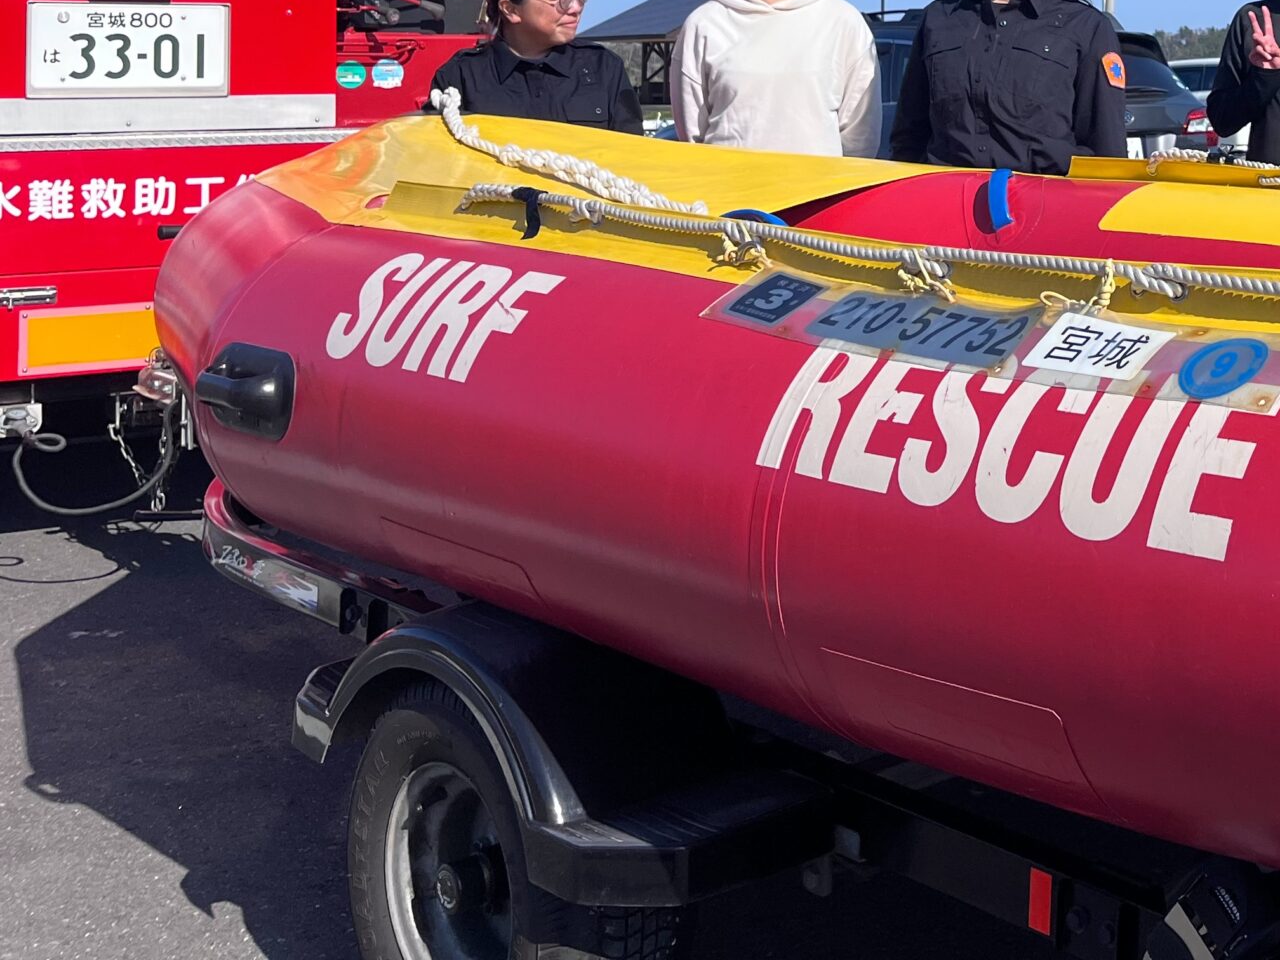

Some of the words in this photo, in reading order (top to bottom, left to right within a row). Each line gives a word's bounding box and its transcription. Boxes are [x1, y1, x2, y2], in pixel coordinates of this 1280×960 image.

[43, 49, 61, 64] は
[68, 33, 205, 80] 33-01
[326, 253, 567, 383] SURF
[754, 288, 794, 310] 3
[818, 296, 1029, 356] 210-57752
[1044, 326, 1150, 369] 宮城
[1210, 351, 1238, 379] 9
